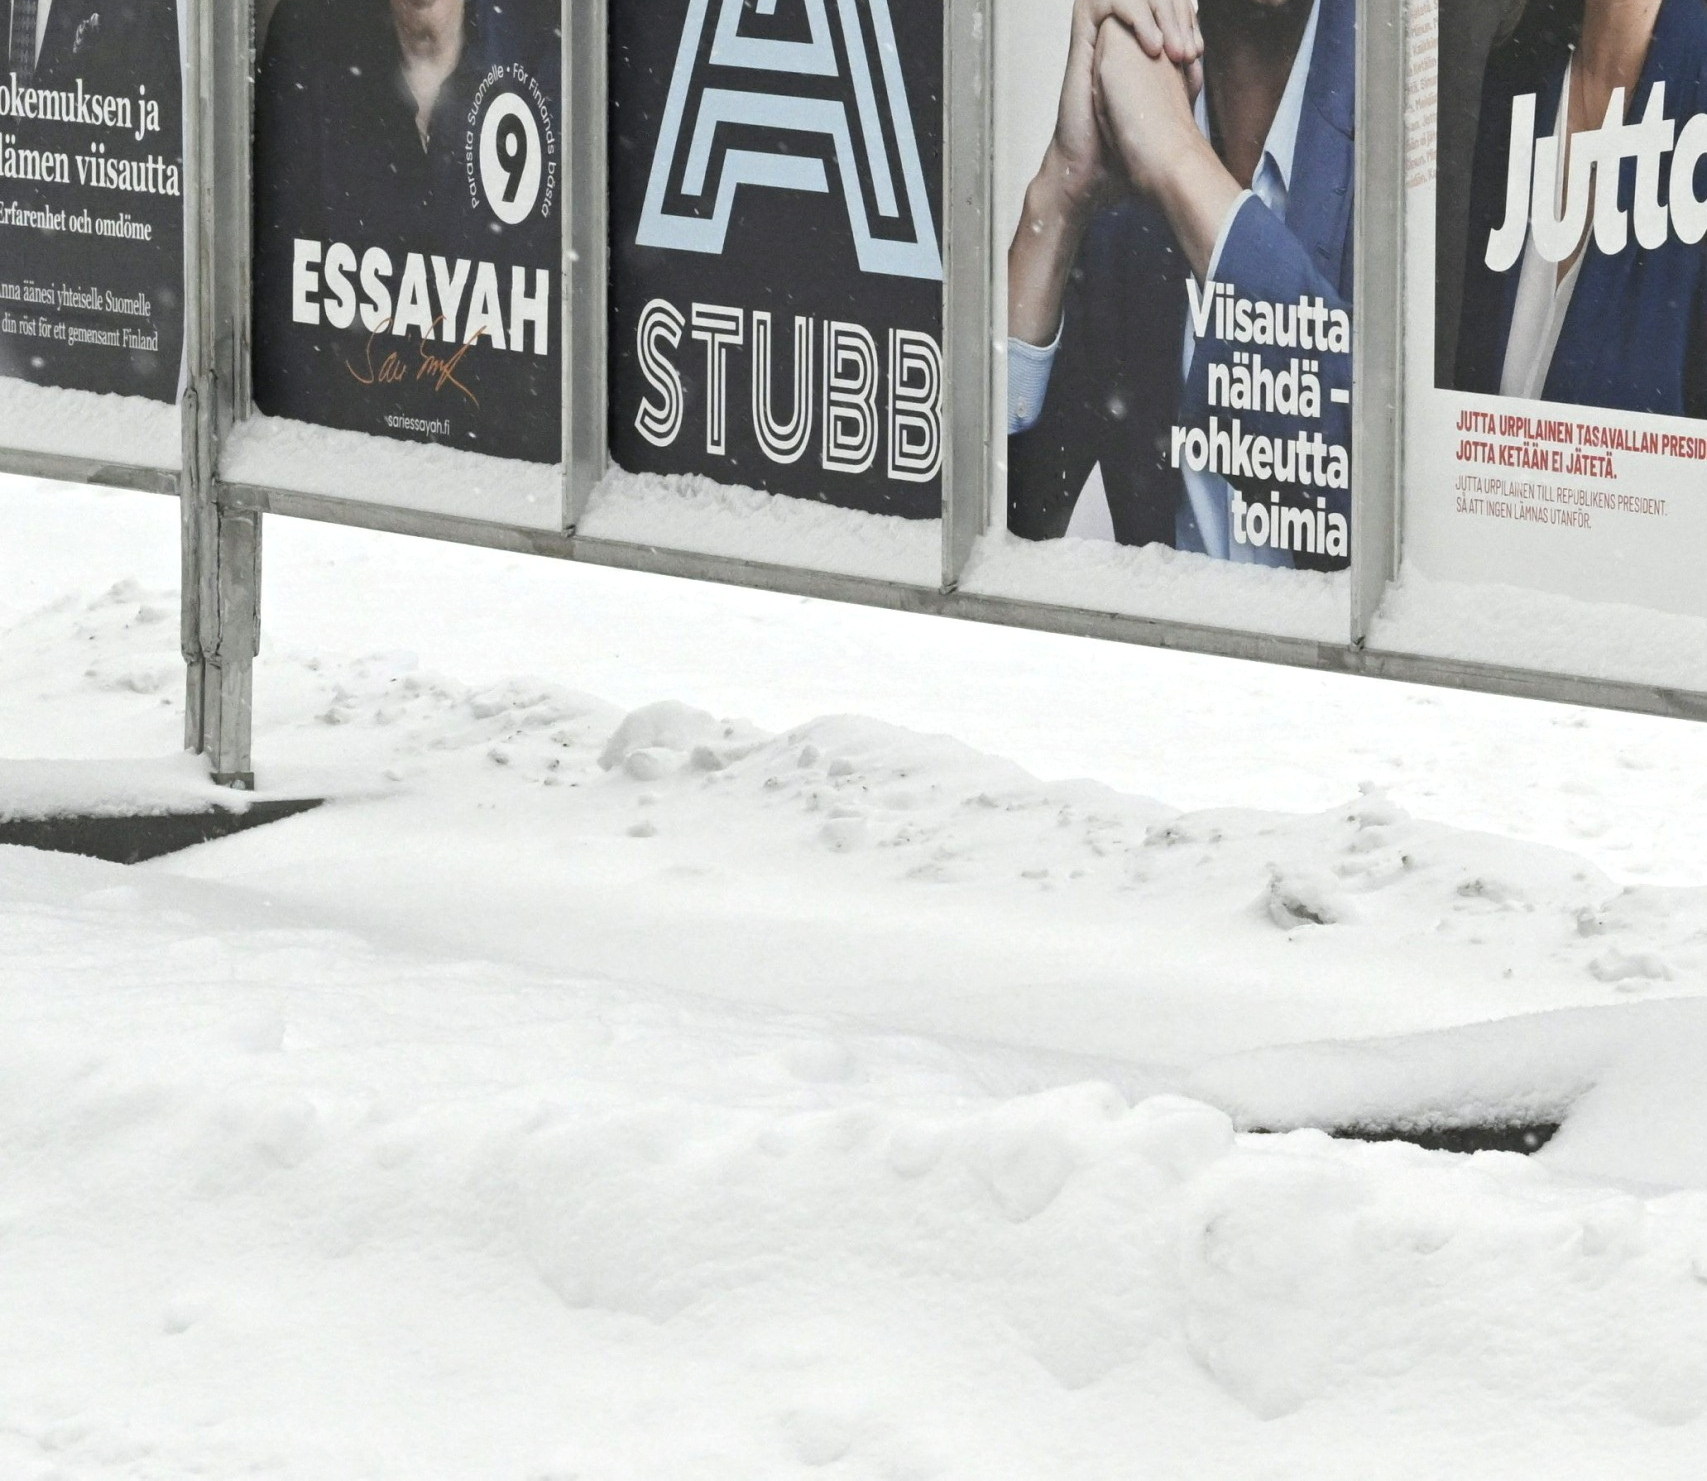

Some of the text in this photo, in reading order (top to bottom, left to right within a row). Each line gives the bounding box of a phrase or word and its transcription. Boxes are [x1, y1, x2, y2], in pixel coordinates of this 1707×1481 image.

[135, 84, 160, 141] ja
[513, 63, 528, 84] För
[528, 78, 555, 155] Finlands
[75, 141, 180, 196] viisautta
[496, 113, 527, 203] 9
[69, 209, 92, 234] och
[95, 213, 152, 241] omdöme
[23, 280, 55, 305] äänesi
[57, 283, 103, 311] yhteiselle
[105, 290, 151, 317] Suomelle
[292, 238, 549, 356] ESSAYAH
[1185, 278, 1350, 354] Viisautta
[2, 312, 158, 351] din röst för ett gemensamt Finland
[634, 298, 942, 483] STUBB
[1208, 351, 1321, 418] nähdä
[388, 413, 450, 437] sariessayah.fi
[1171, 416, 1349, 489] rohkeutta
[1456, 410, 1496, 435] JUTTA
[1499, 415, 1573, 444] URPILAINEN
[1576, 423, 1659, 454] TASAVALLAN
[1456, 440, 1617, 479] JOTTA KETÄÄN EI JÄTETÄ.
[1231, 490, 1348, 557] toimia
[1455, 475, 1667, 516] JUTTA URPILAINEN TILL REPUBLIKENS PRESIDENT.
[1456, 492, 1592, 529] SÅ ATT INGEN LÄMNAS UTANFÖR.
